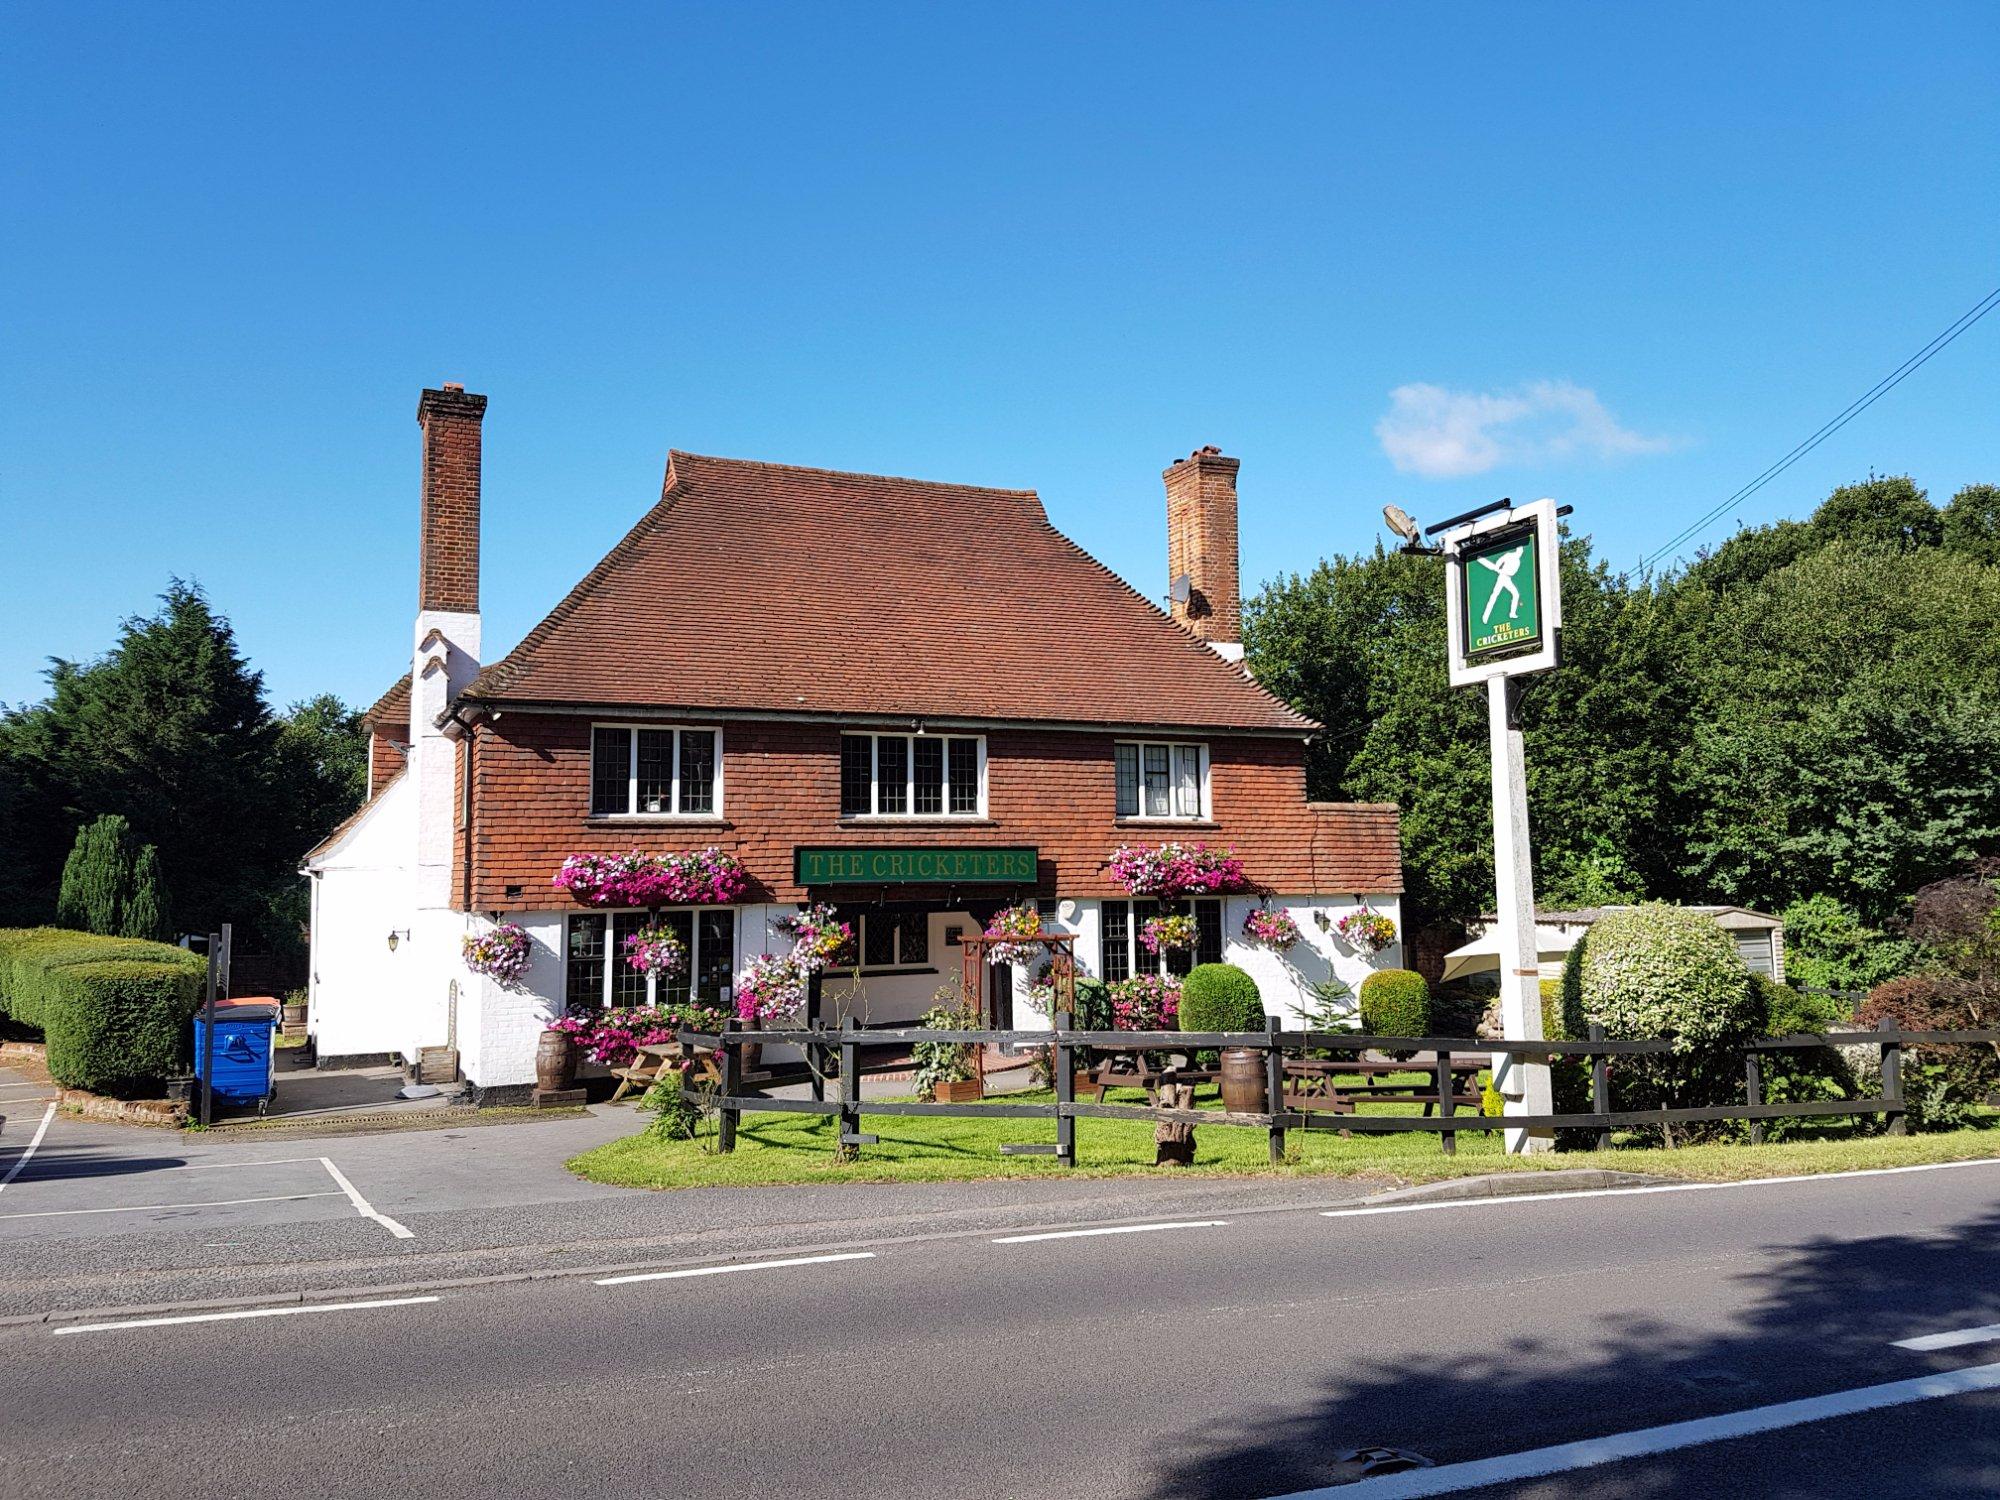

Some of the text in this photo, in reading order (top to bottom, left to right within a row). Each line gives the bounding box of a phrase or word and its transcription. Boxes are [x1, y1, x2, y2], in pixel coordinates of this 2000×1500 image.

[1476, 626, 1530, 647] CRICKETERS
[1493, 622, 1511, 634] THE
[809, 854, 1030, 877] THE CRICKETERS
